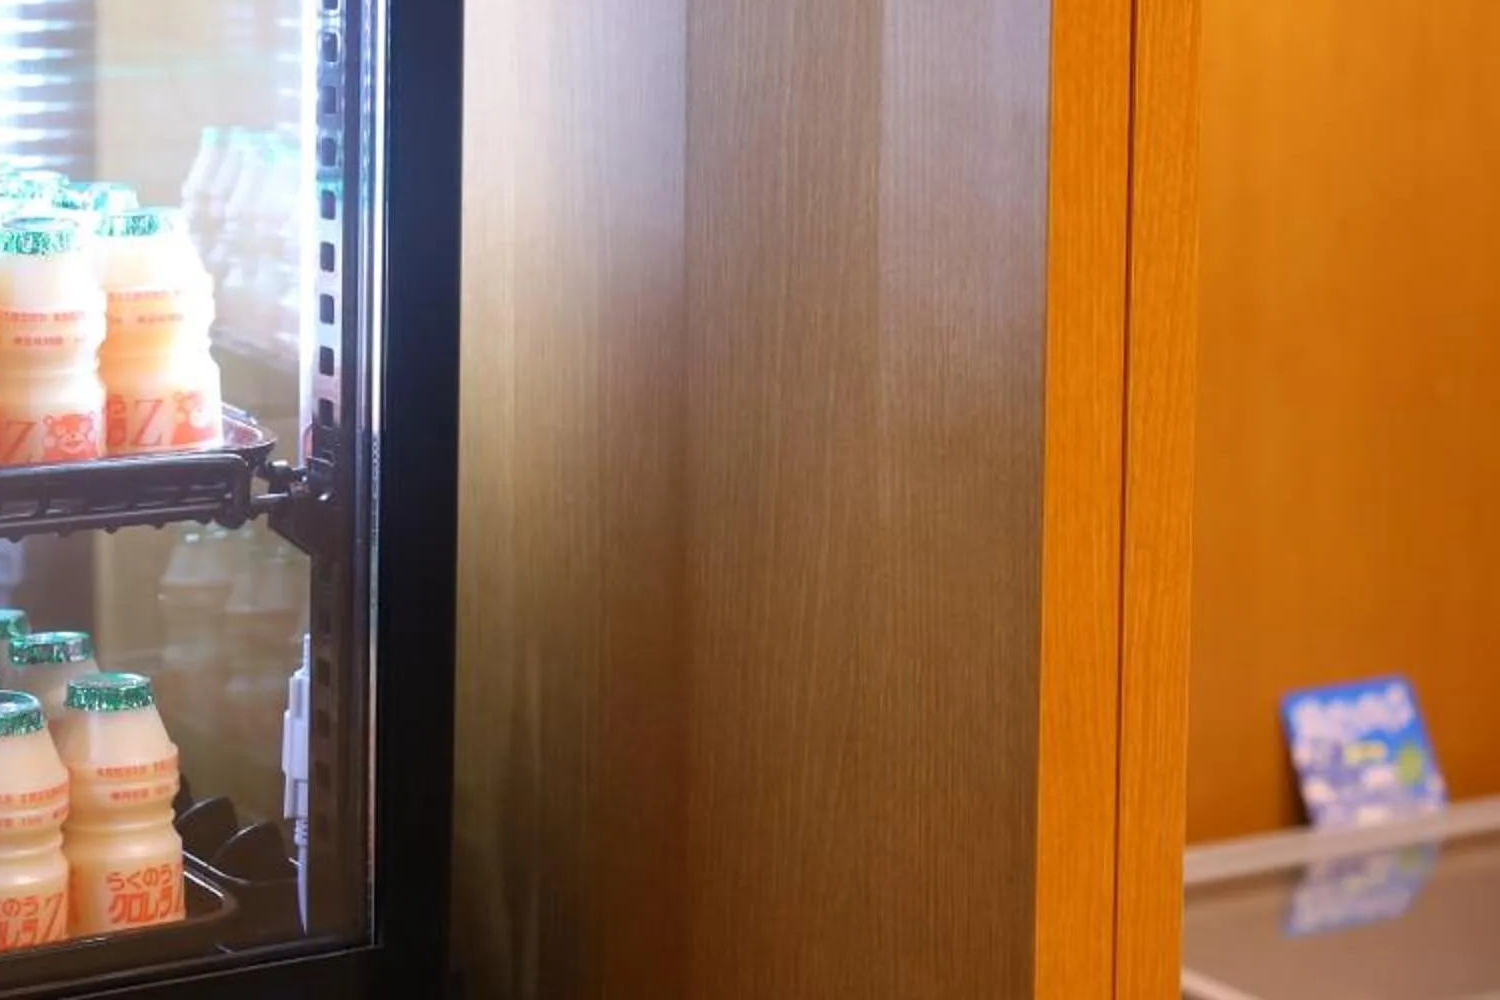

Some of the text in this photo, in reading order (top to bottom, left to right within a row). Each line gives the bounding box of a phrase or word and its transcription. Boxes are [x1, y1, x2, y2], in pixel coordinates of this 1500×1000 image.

[130, 398, 164, 447] Z
[106, 862, 173, 892] らくのう
[108, 885, 174, 924] クロレラ
